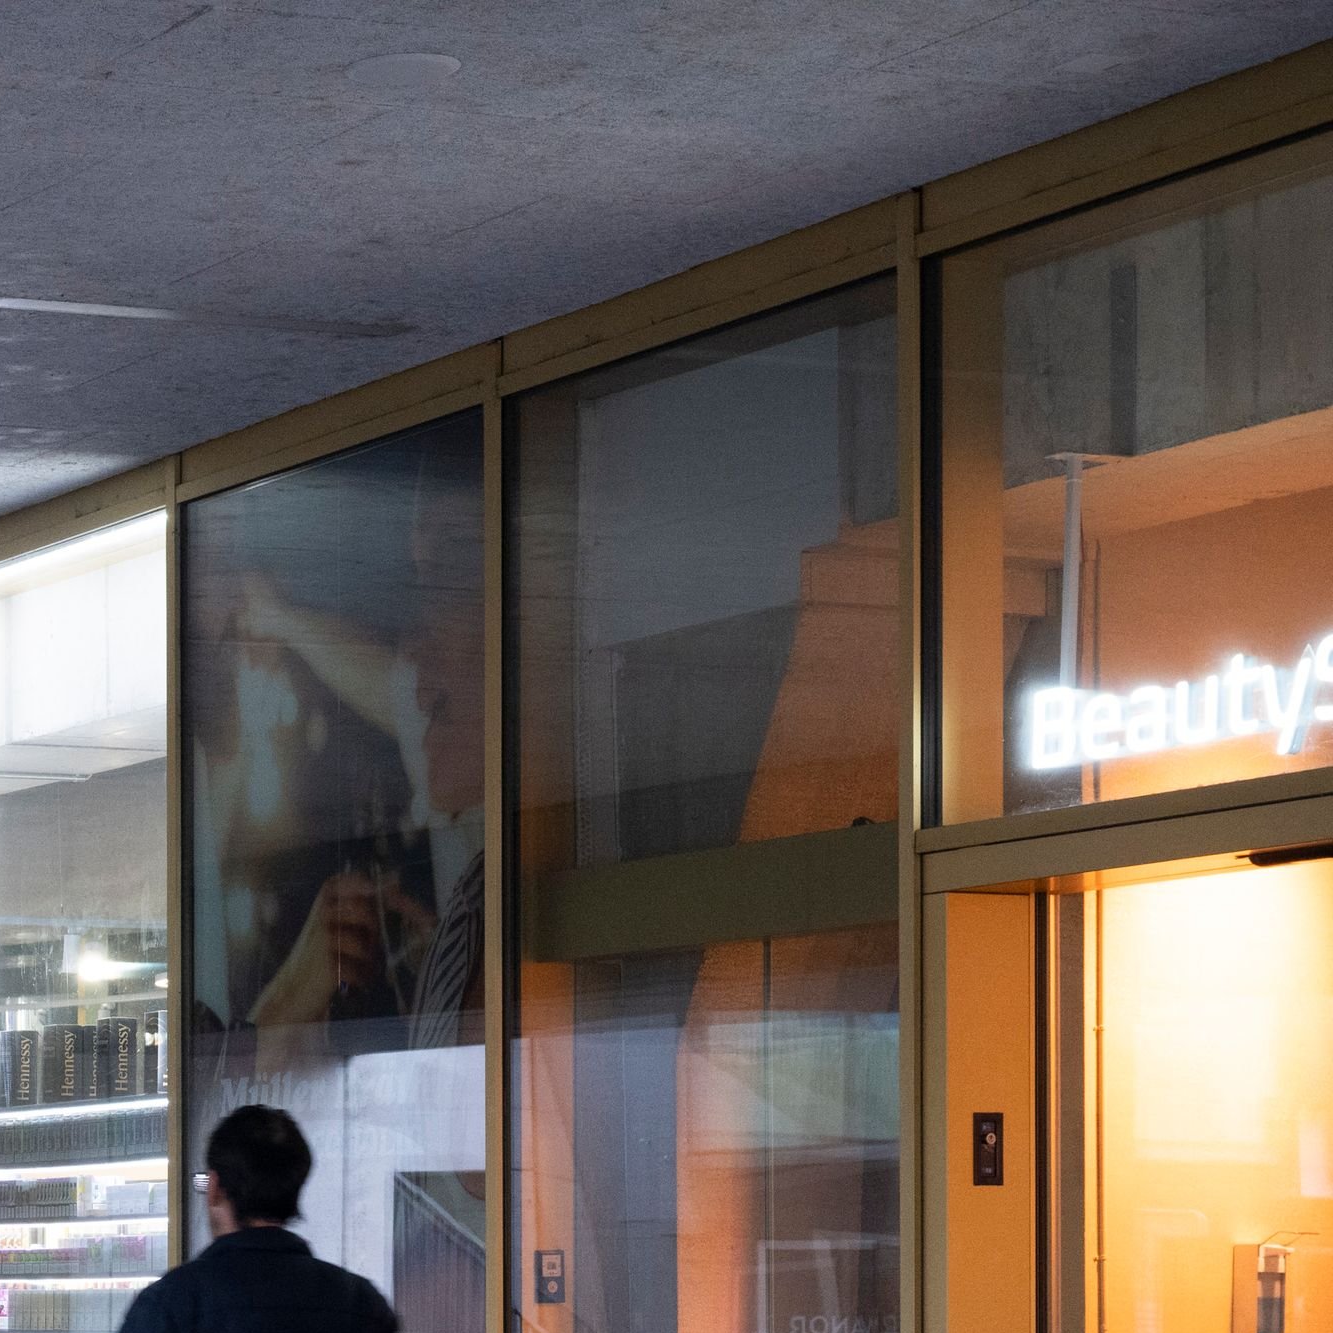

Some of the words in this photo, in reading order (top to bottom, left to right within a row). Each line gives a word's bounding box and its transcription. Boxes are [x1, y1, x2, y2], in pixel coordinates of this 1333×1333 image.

[17, 1036, 33, 1101] Hennessy
[61, 1030, 76, 1097] Hennessy
[115, 1024, 131, 1092] Hennessy
